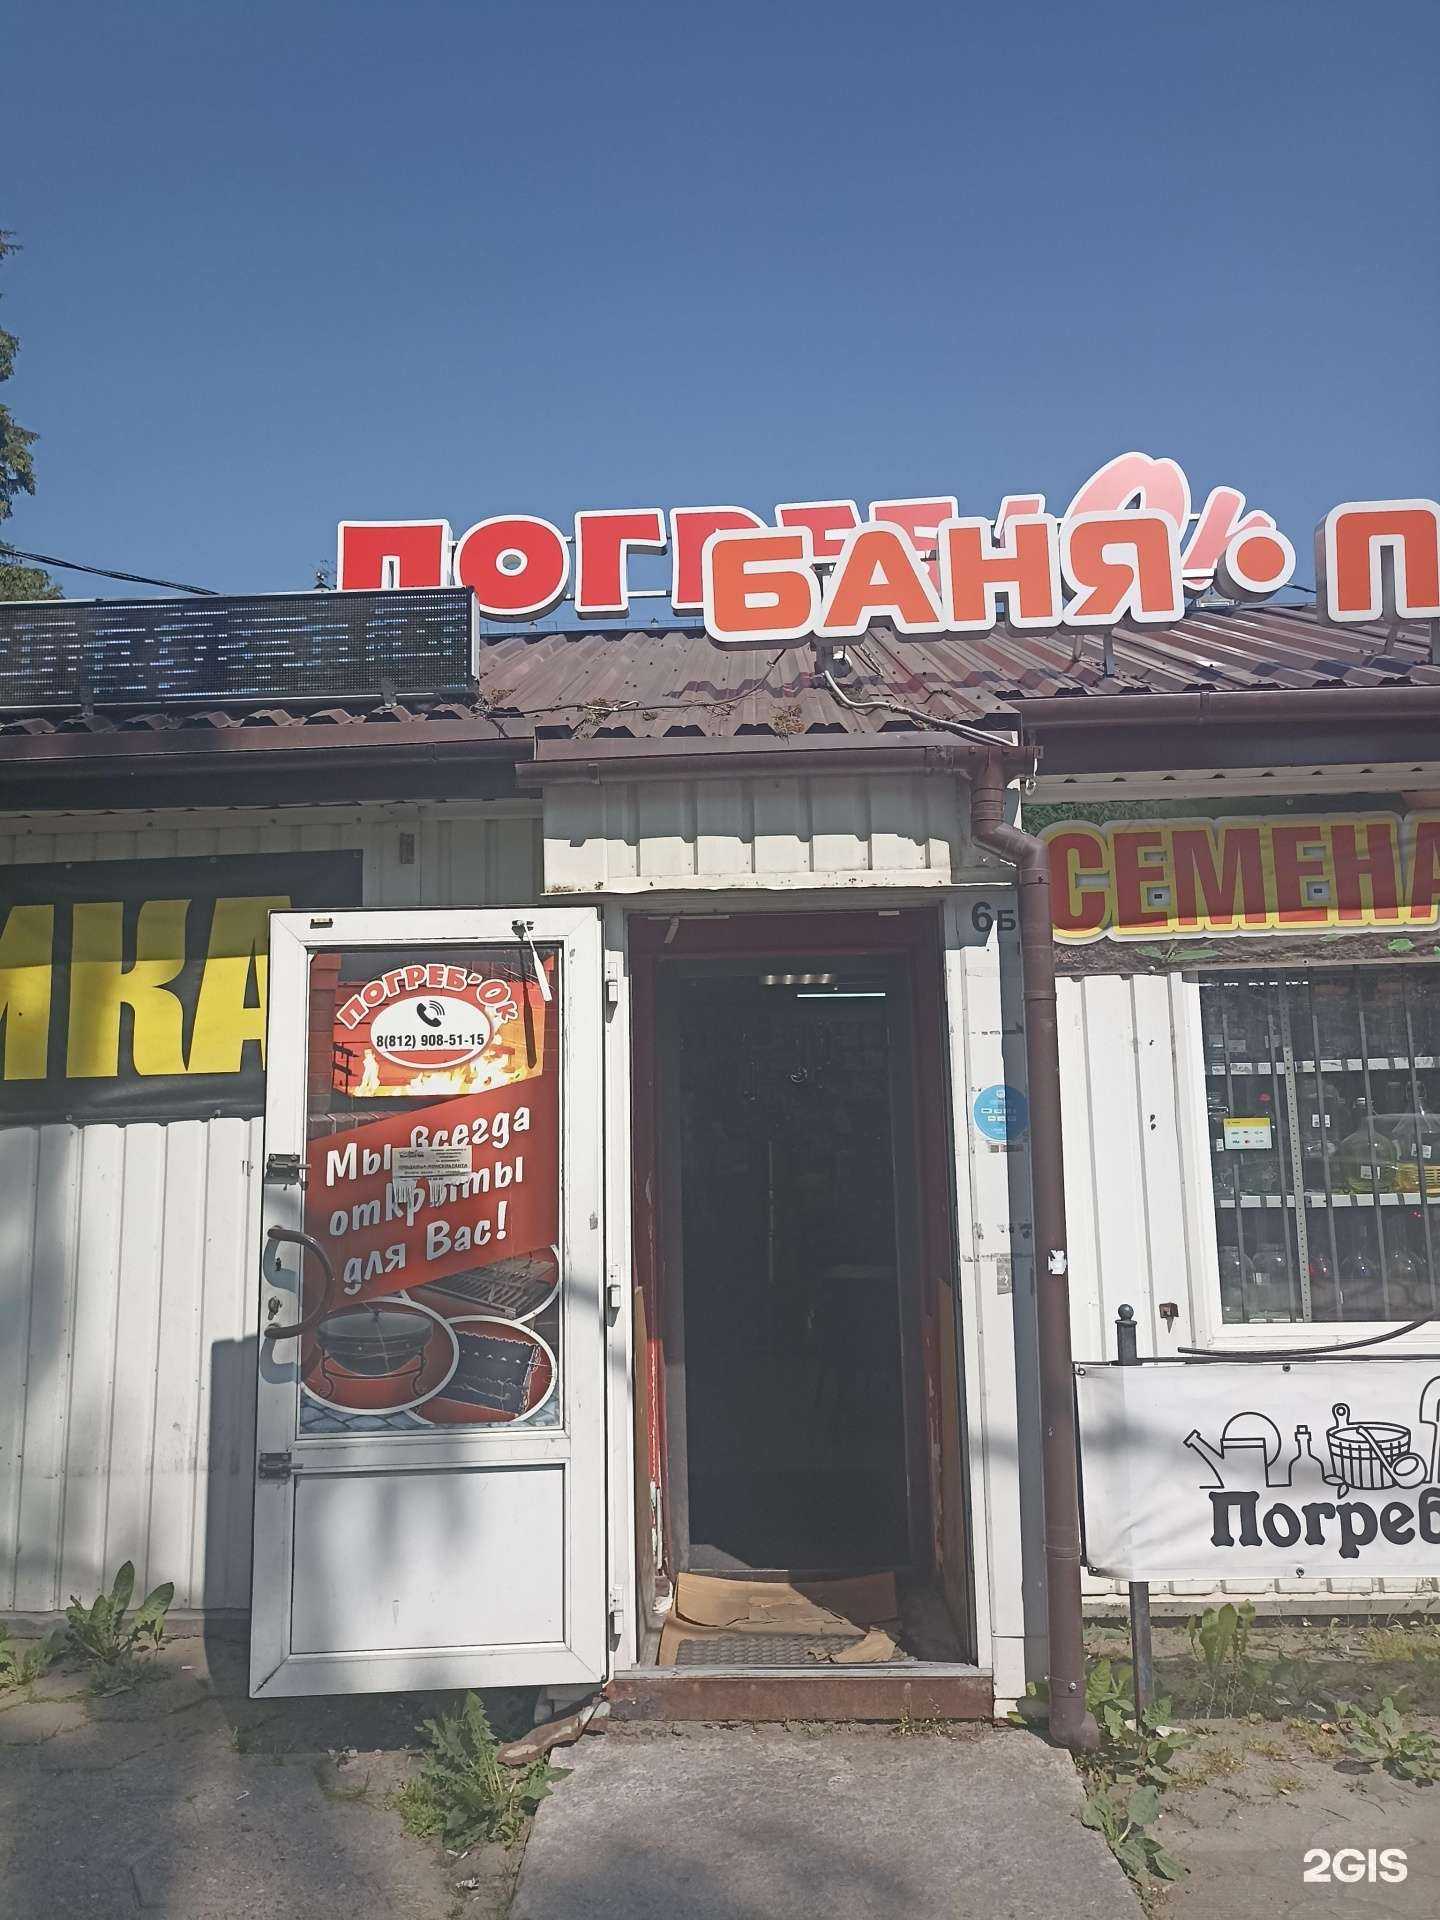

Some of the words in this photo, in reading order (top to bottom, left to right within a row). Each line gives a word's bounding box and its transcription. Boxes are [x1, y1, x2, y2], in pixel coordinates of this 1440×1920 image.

[702, 507, 1185, 643] БАНЯ
[376, 1035, 416, 1049] 8(812)
[420, 1033, 485, 1047] 908-51-15
[326, 1142, 392, 1187] Мы
[343, 1243, 406, 1295] для
[426, 1200, 508, 1261] Вас!
